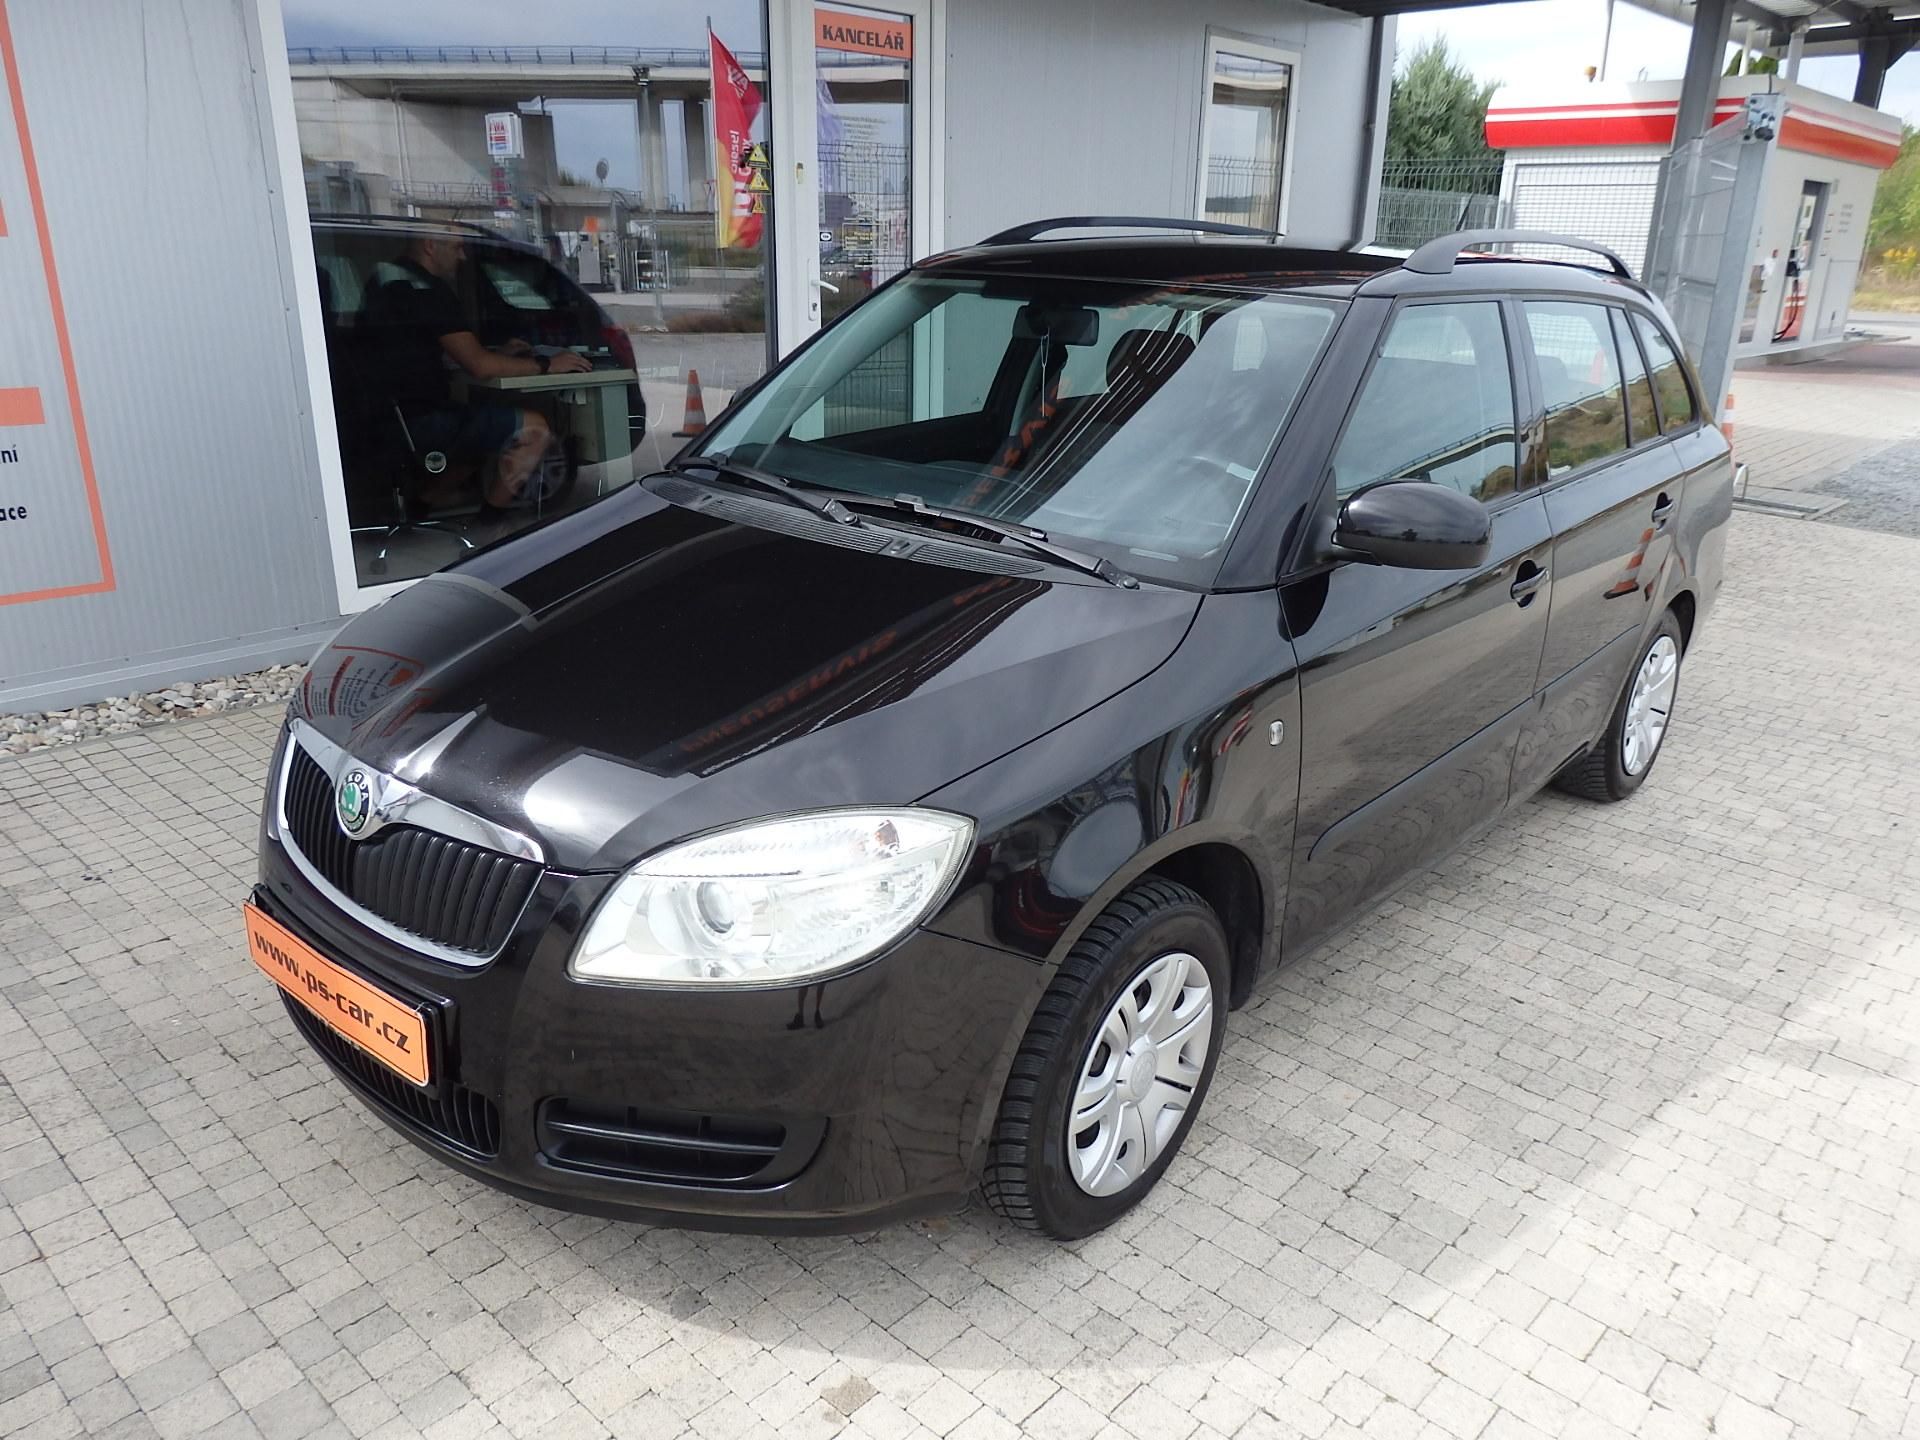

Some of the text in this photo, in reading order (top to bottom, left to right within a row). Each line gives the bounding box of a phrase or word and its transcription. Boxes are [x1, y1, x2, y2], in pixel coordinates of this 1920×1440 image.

[822, 24, 904, 51] KANCELÁŘ
[0, 443, 19, 464] ní
[253, 930, 411, 1055] www.ps-car.cz
